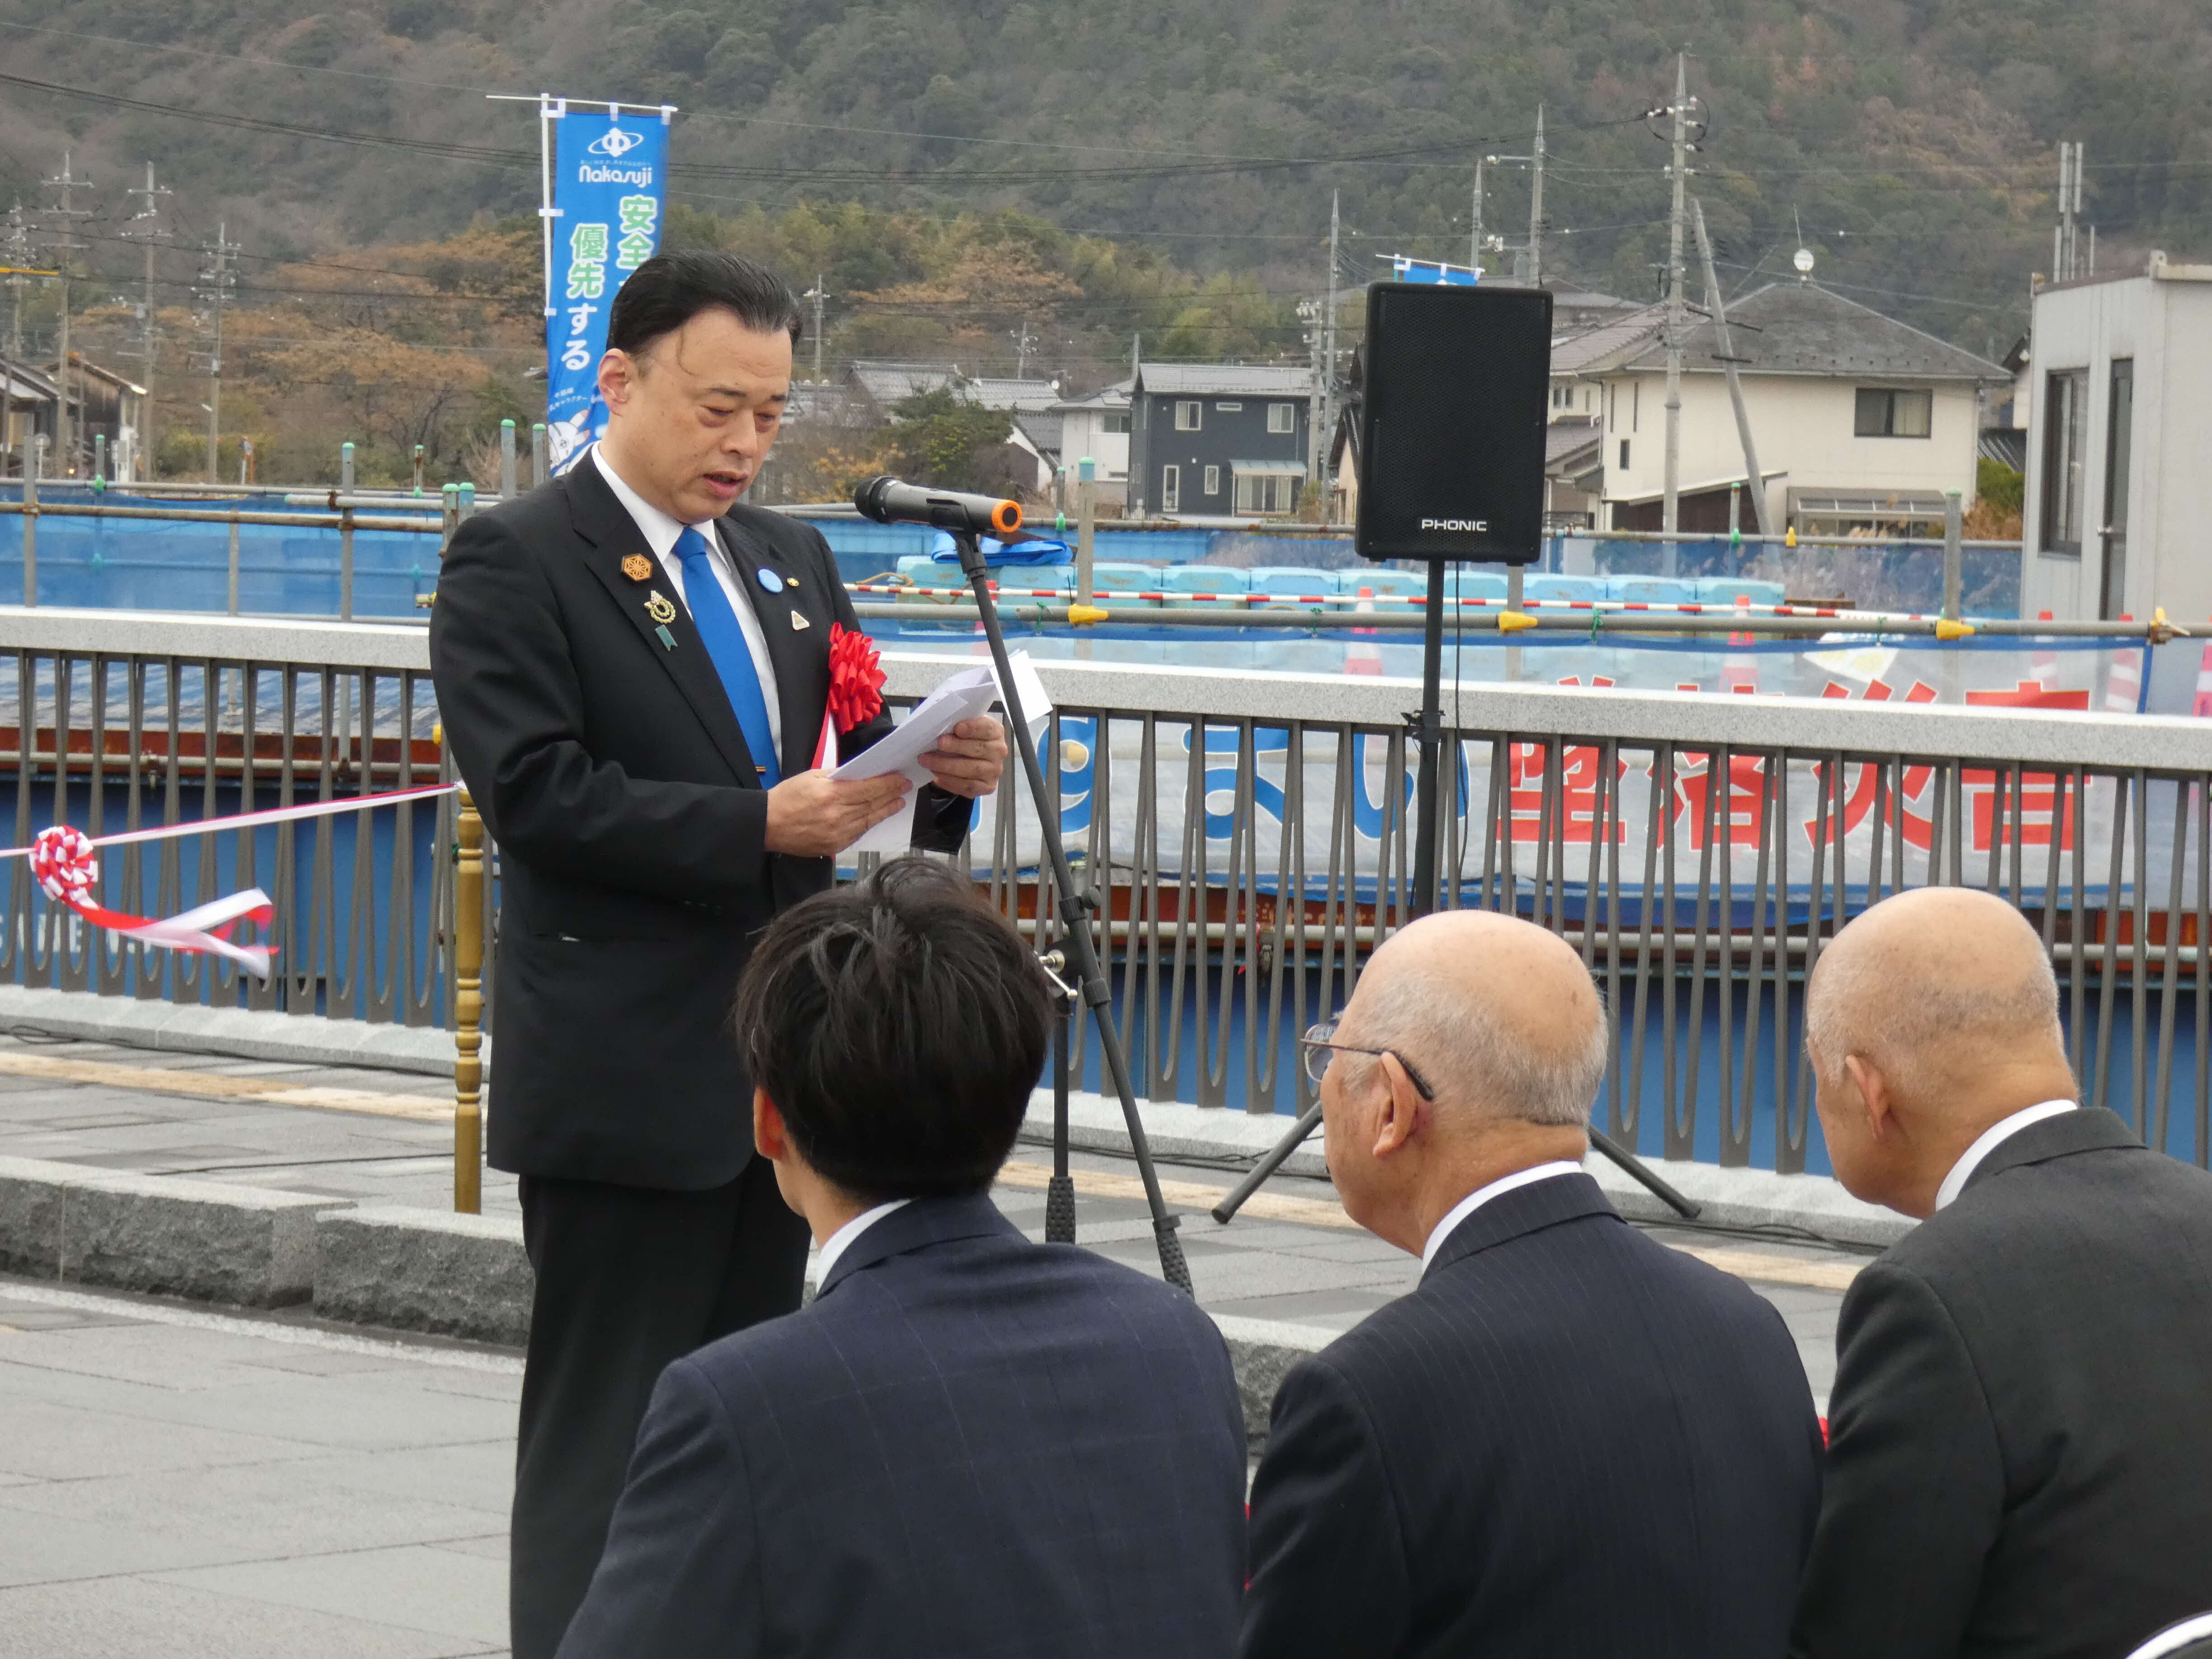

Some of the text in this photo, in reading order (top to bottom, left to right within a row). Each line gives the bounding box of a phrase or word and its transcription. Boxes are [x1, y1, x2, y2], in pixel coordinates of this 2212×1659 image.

[616, 195, 657, 288] 安全
[561, 223, 609, 370] 優先する
[1421, 519, 1487, 532] PHONIC
